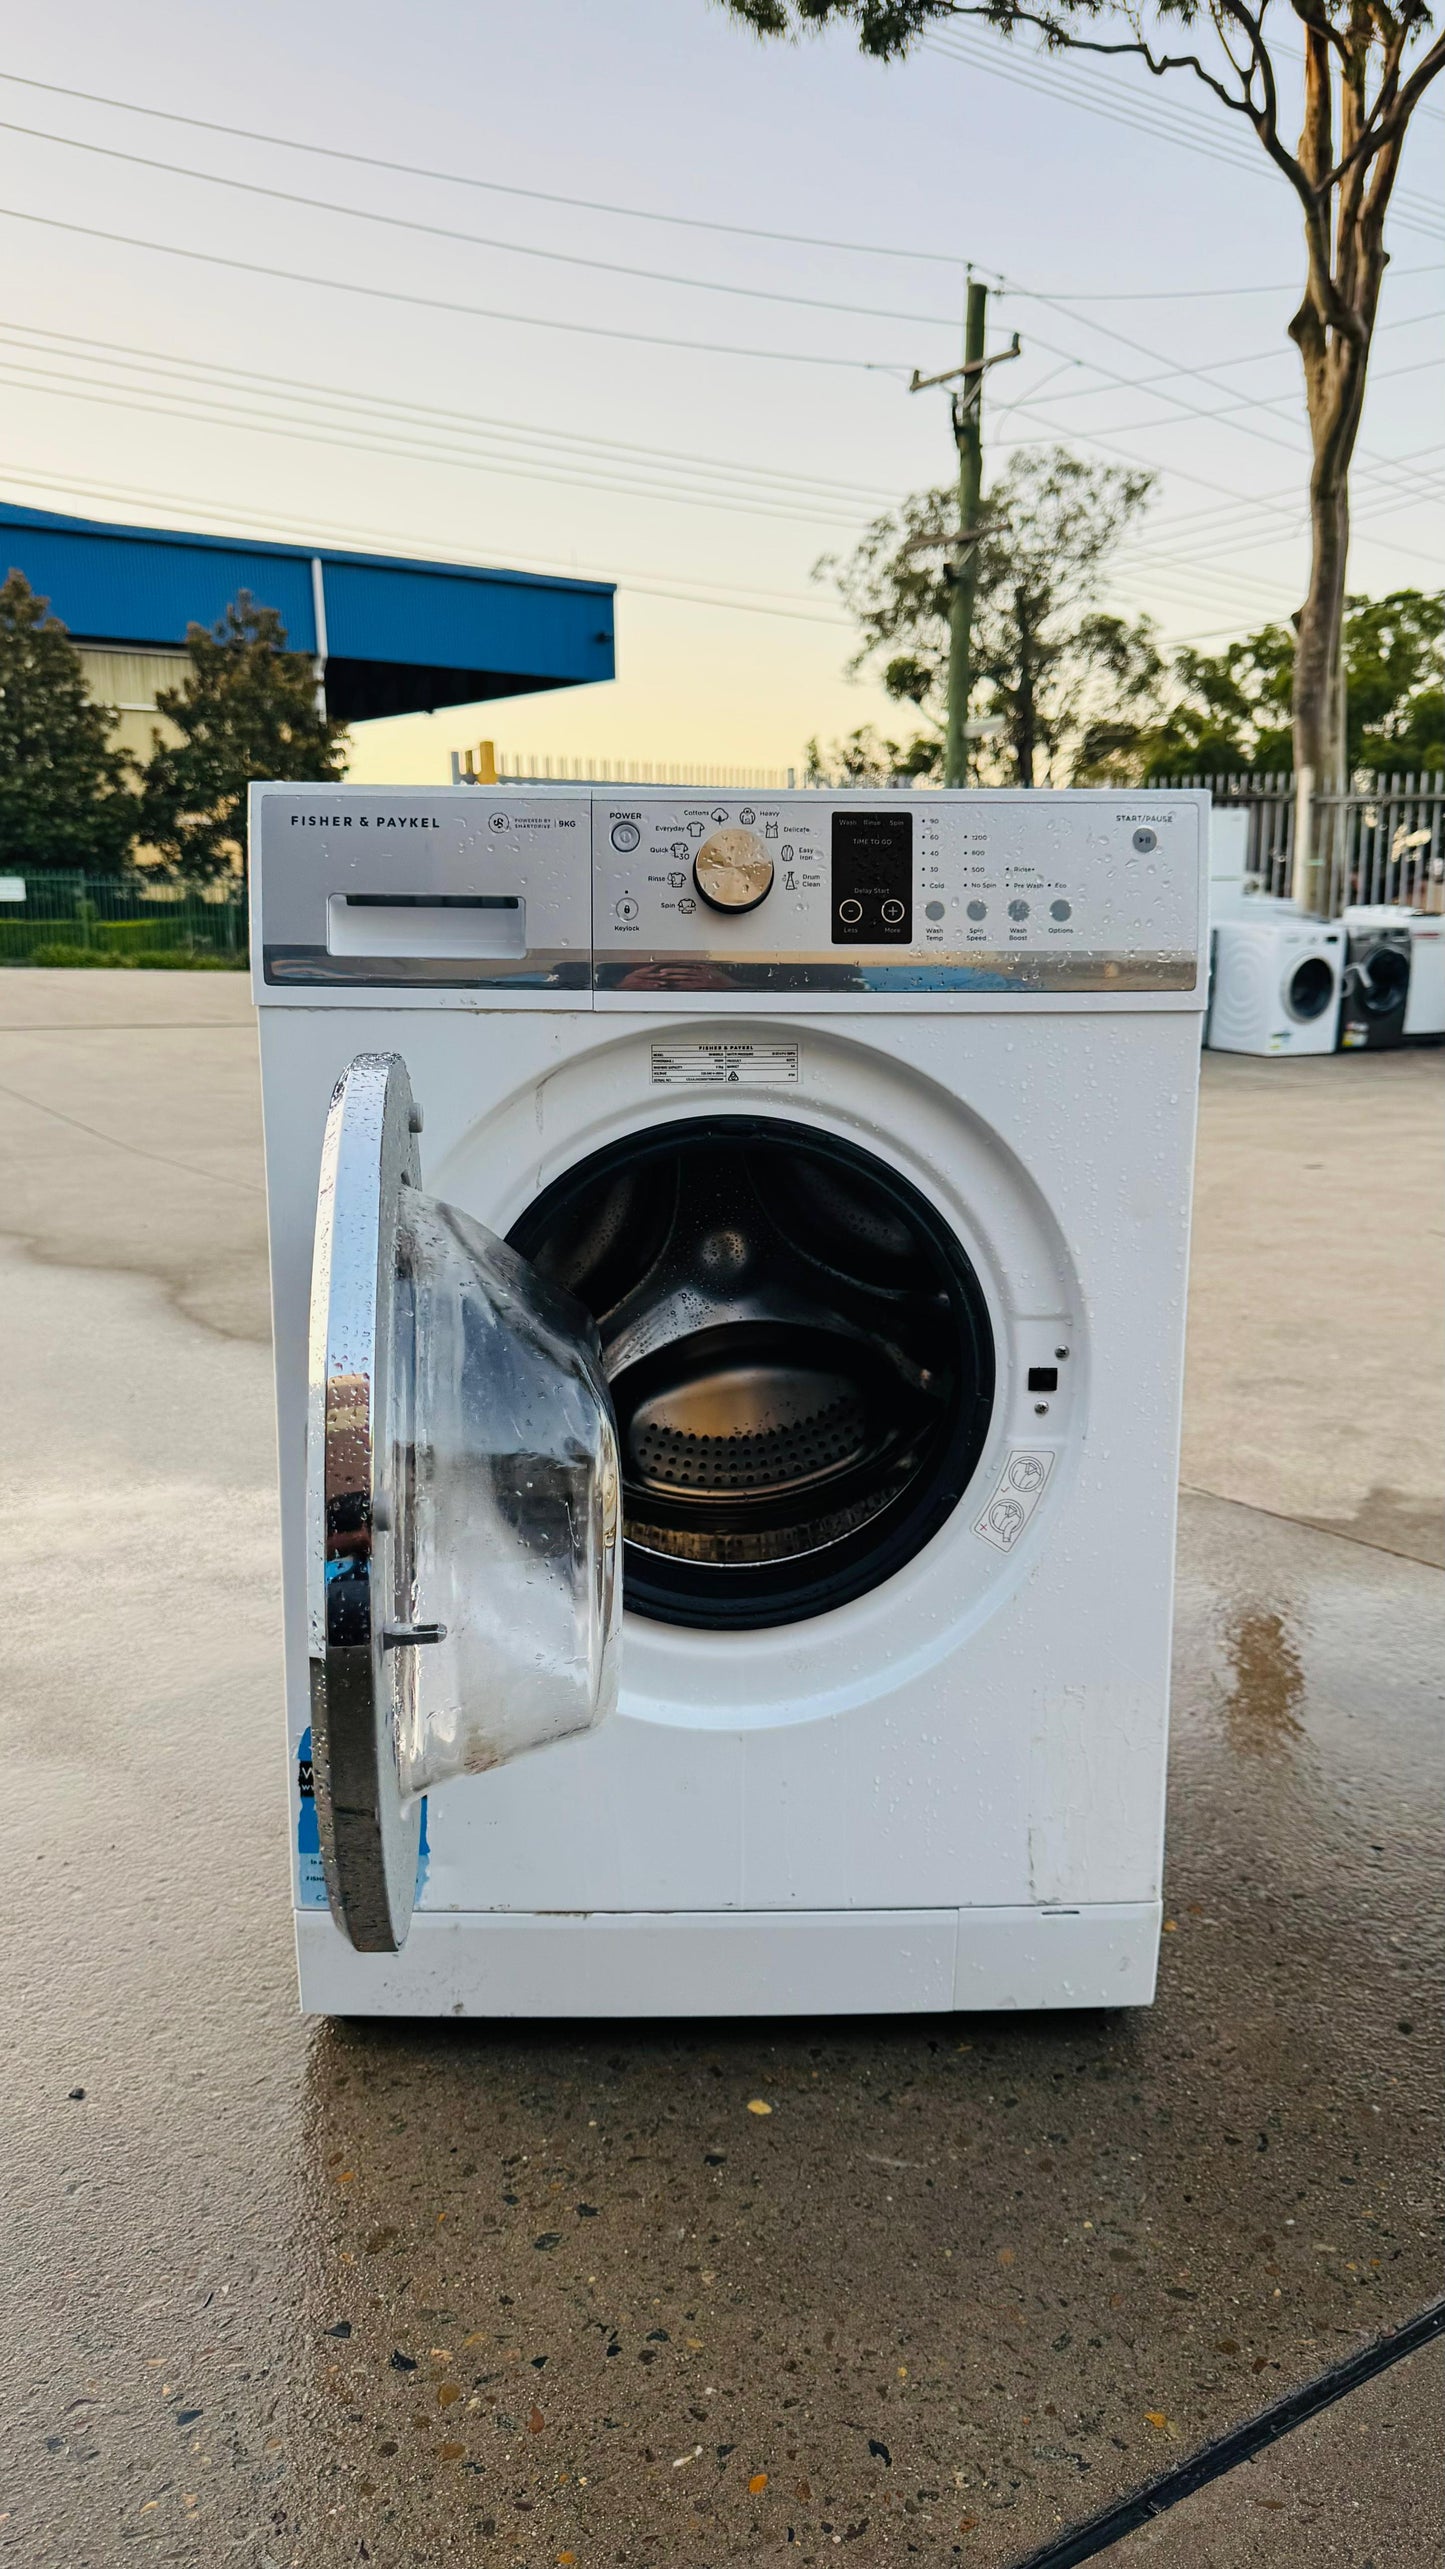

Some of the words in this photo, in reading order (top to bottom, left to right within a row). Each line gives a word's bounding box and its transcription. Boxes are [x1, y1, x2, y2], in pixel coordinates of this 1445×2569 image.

[291, 815, 352, 827] FISHER
[359, 816, 369, 827] &
[376, 816, 440, 828] PAYKEL
[889, 819, 904, 827] Spin
[1116, 815, 1173, 823] START/PAUSE
[558, 820, 576, 828] 9KG
[655, 825, 685, 833] Everyday
[881, 838, 892, 846] GO
[650, 846, 669, 854] Quick
[873, 887, 890, 895] Start
[1048, 927, 1074, 935] Options
